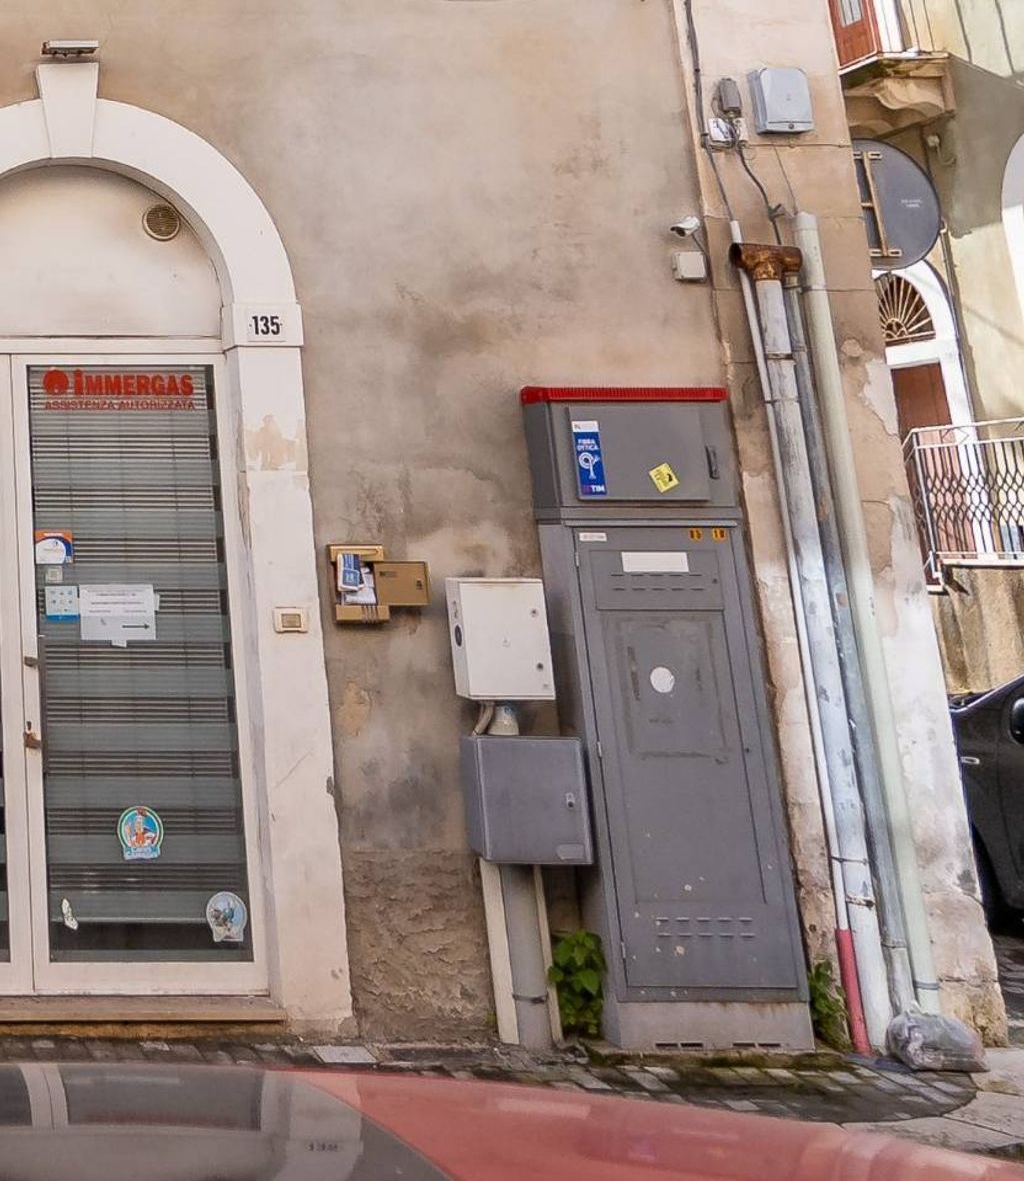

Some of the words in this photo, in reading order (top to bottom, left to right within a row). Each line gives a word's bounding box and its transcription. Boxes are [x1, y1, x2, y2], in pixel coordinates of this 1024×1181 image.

[251, 315, 280, 335] 135
[45, 399, 115, 411] ASSISTENZA
[118, 399, 196, 411] AUTORIZZATA
[591, 484, 605, 493] TIM
